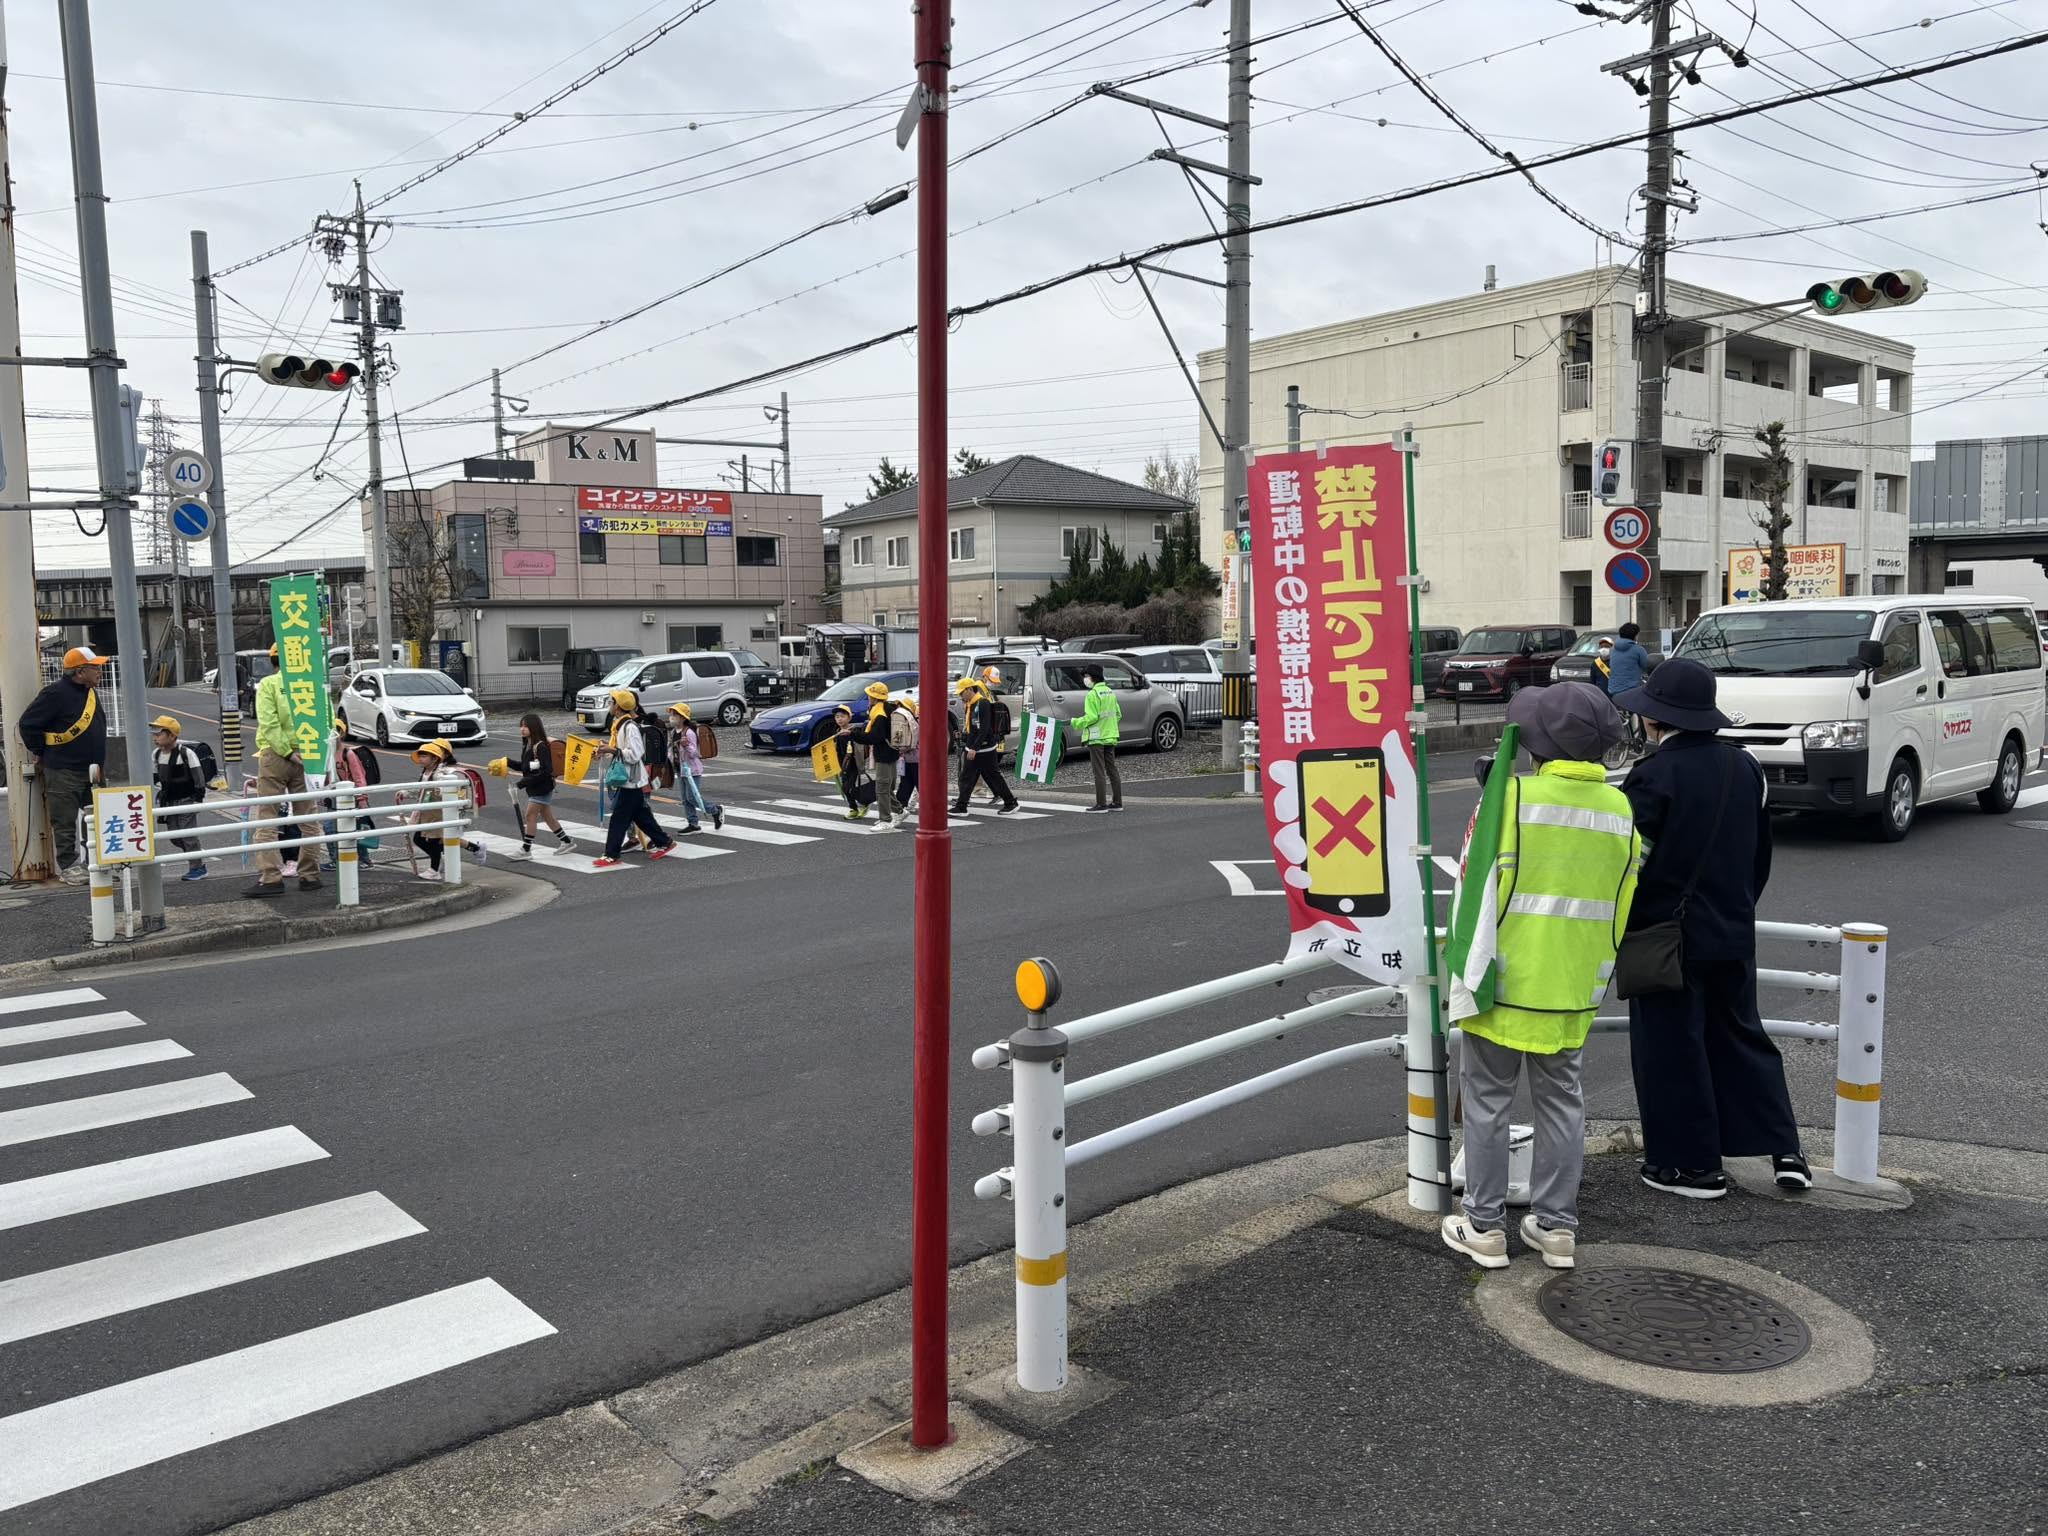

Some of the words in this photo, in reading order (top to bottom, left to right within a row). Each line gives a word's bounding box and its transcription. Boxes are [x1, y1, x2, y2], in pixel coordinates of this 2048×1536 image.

[567, 434, 592, 460] K
[597, 448, 608, 460] &
[612, 437, 639, 462] M
[175, 462, 202, 482] 40
[586, 488, 723, 505] コインランドリー
[1614, 518, 1640, 538] 50
[102, 815, 125, 855] 右左
[127, 793, 147, 853] とまって
